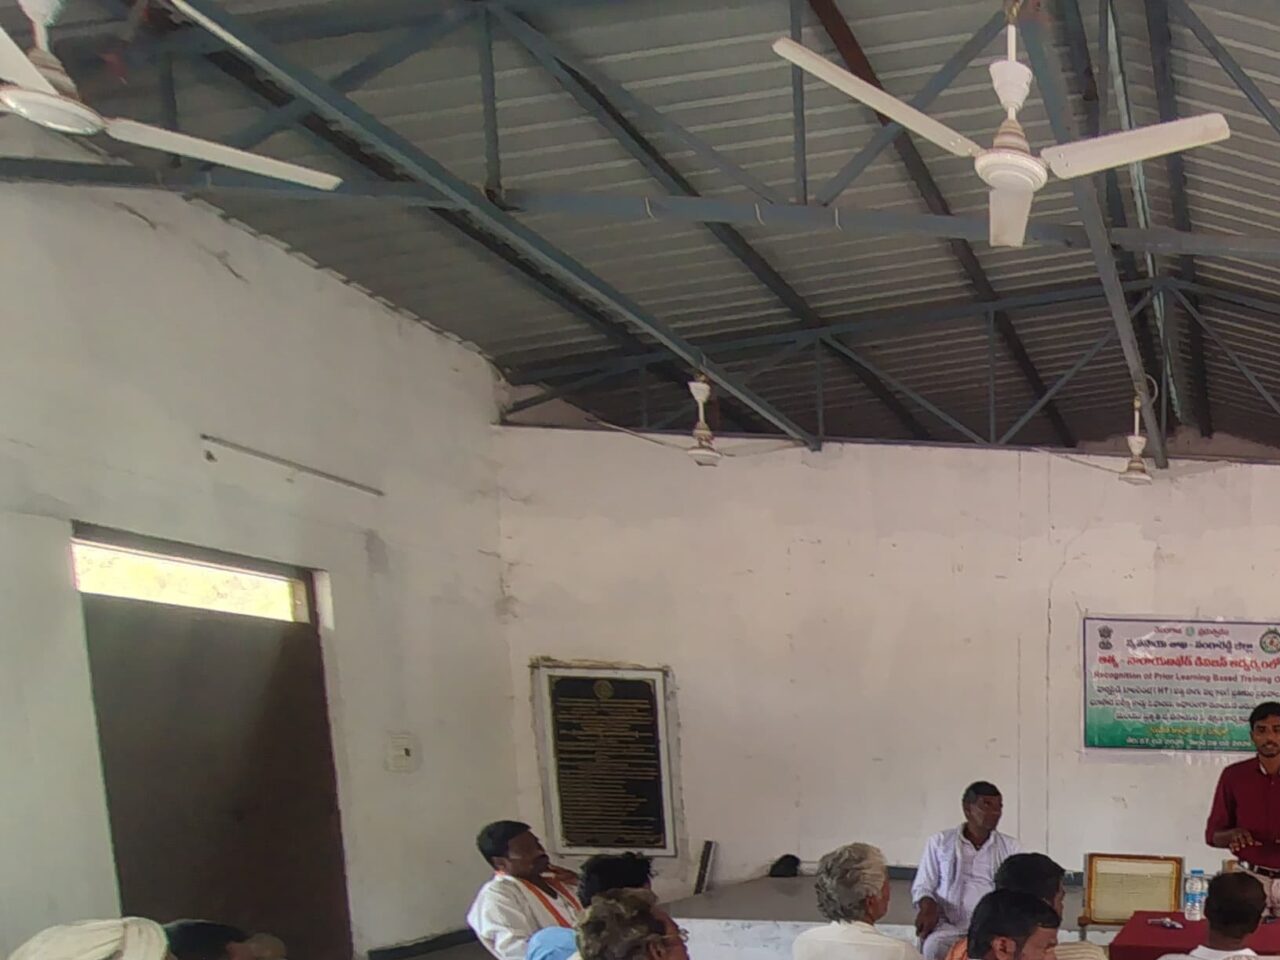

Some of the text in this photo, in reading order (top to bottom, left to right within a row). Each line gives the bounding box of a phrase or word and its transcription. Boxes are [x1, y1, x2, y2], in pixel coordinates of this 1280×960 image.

[1094, 671, 1141, 680] Recognition
[1154, 672, 1174, 680] Prior
[1175, 672, 1211, 682] Learning
[1213, 673, 1238, 682] Based
[1240, 674, 1272, 684] Training
